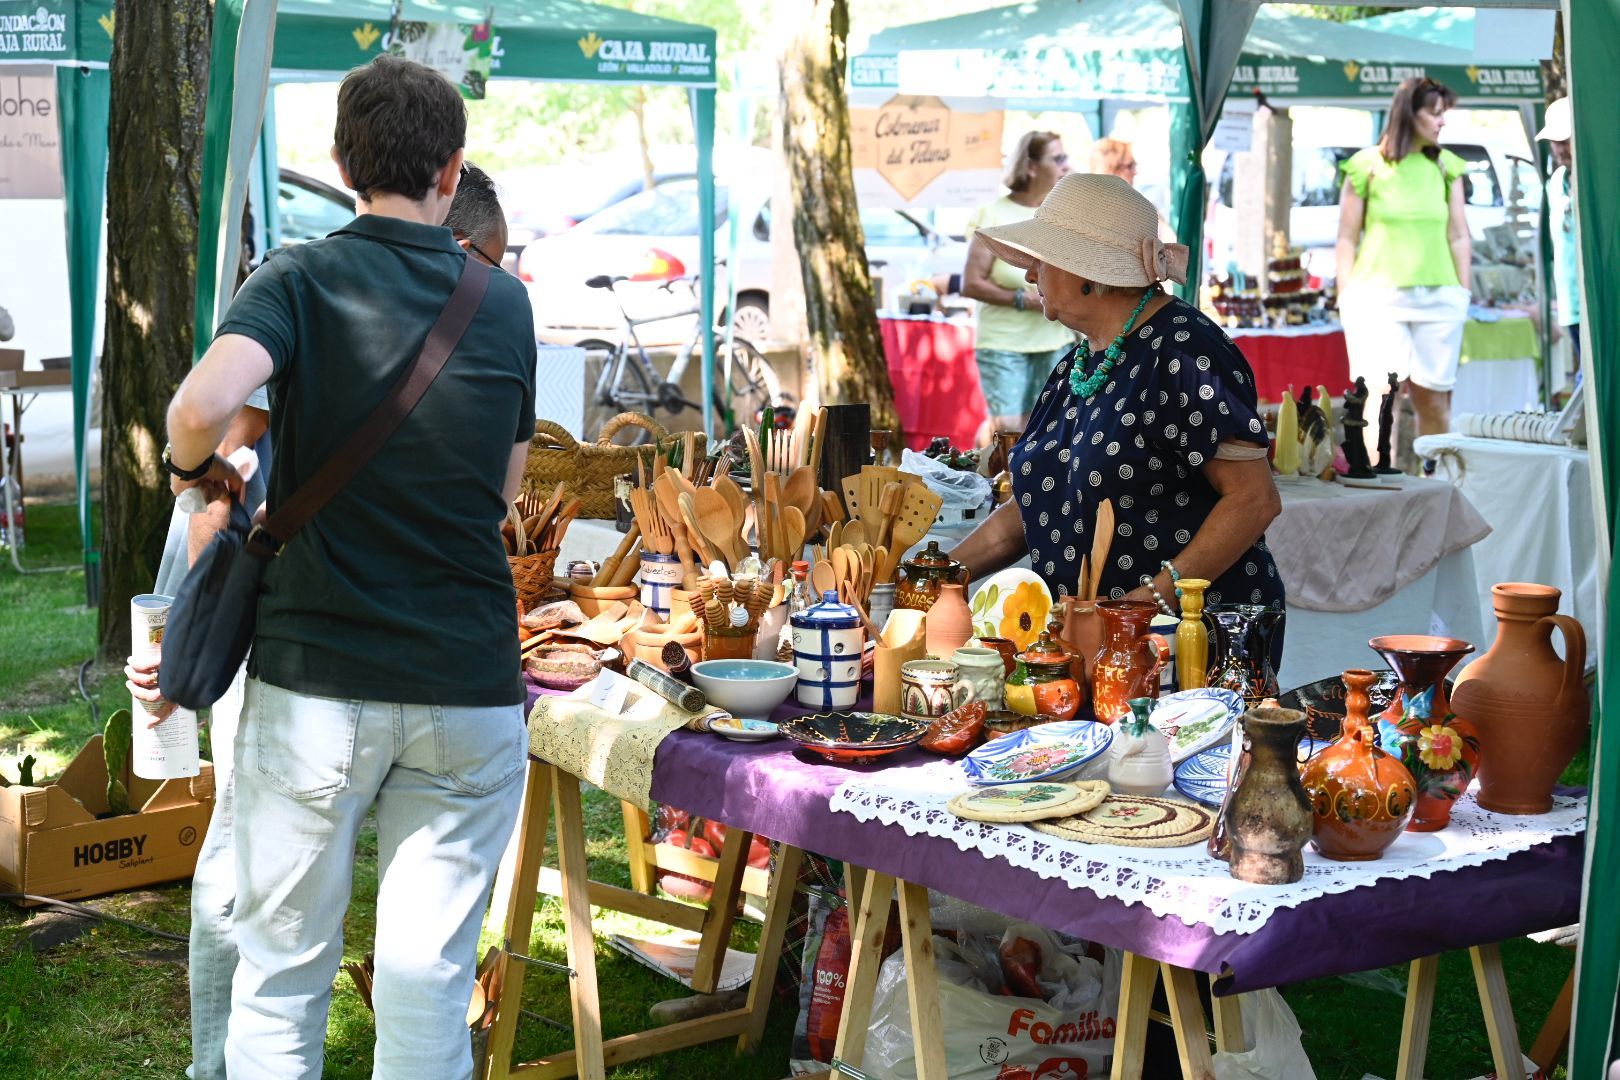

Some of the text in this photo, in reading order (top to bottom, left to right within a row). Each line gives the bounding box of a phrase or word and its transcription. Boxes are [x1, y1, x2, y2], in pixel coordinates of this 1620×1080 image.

[22, 33, 66, 51] RURAL
[599, 40, 711, 63] CAJA RURAL
[1257, 66, 1299, 82] RURAL
[1361, 66, 1388, 82] CAJA
[1479, 69, 1504, 84] CAJA
[74, 834, 147, 867] HOBBY
[816, 969, 845, 988] 100%
